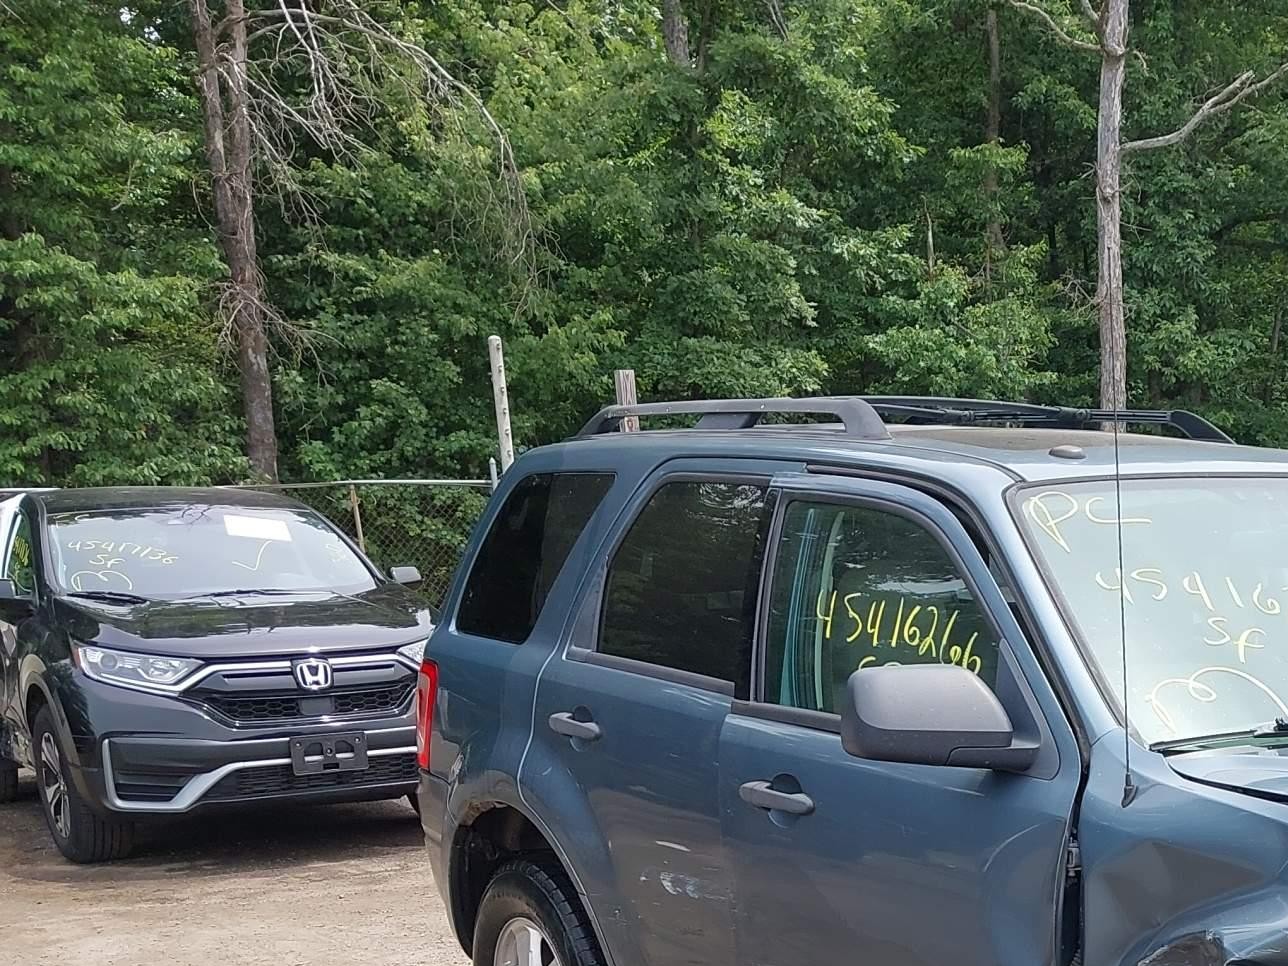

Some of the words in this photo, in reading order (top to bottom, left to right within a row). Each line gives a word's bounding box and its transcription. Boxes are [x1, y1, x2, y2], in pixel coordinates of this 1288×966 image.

[68, 540, 179, 565] 45417136
[1023, 490, 1151, 553] PC
[816, 590, 982, 675] 45416266
